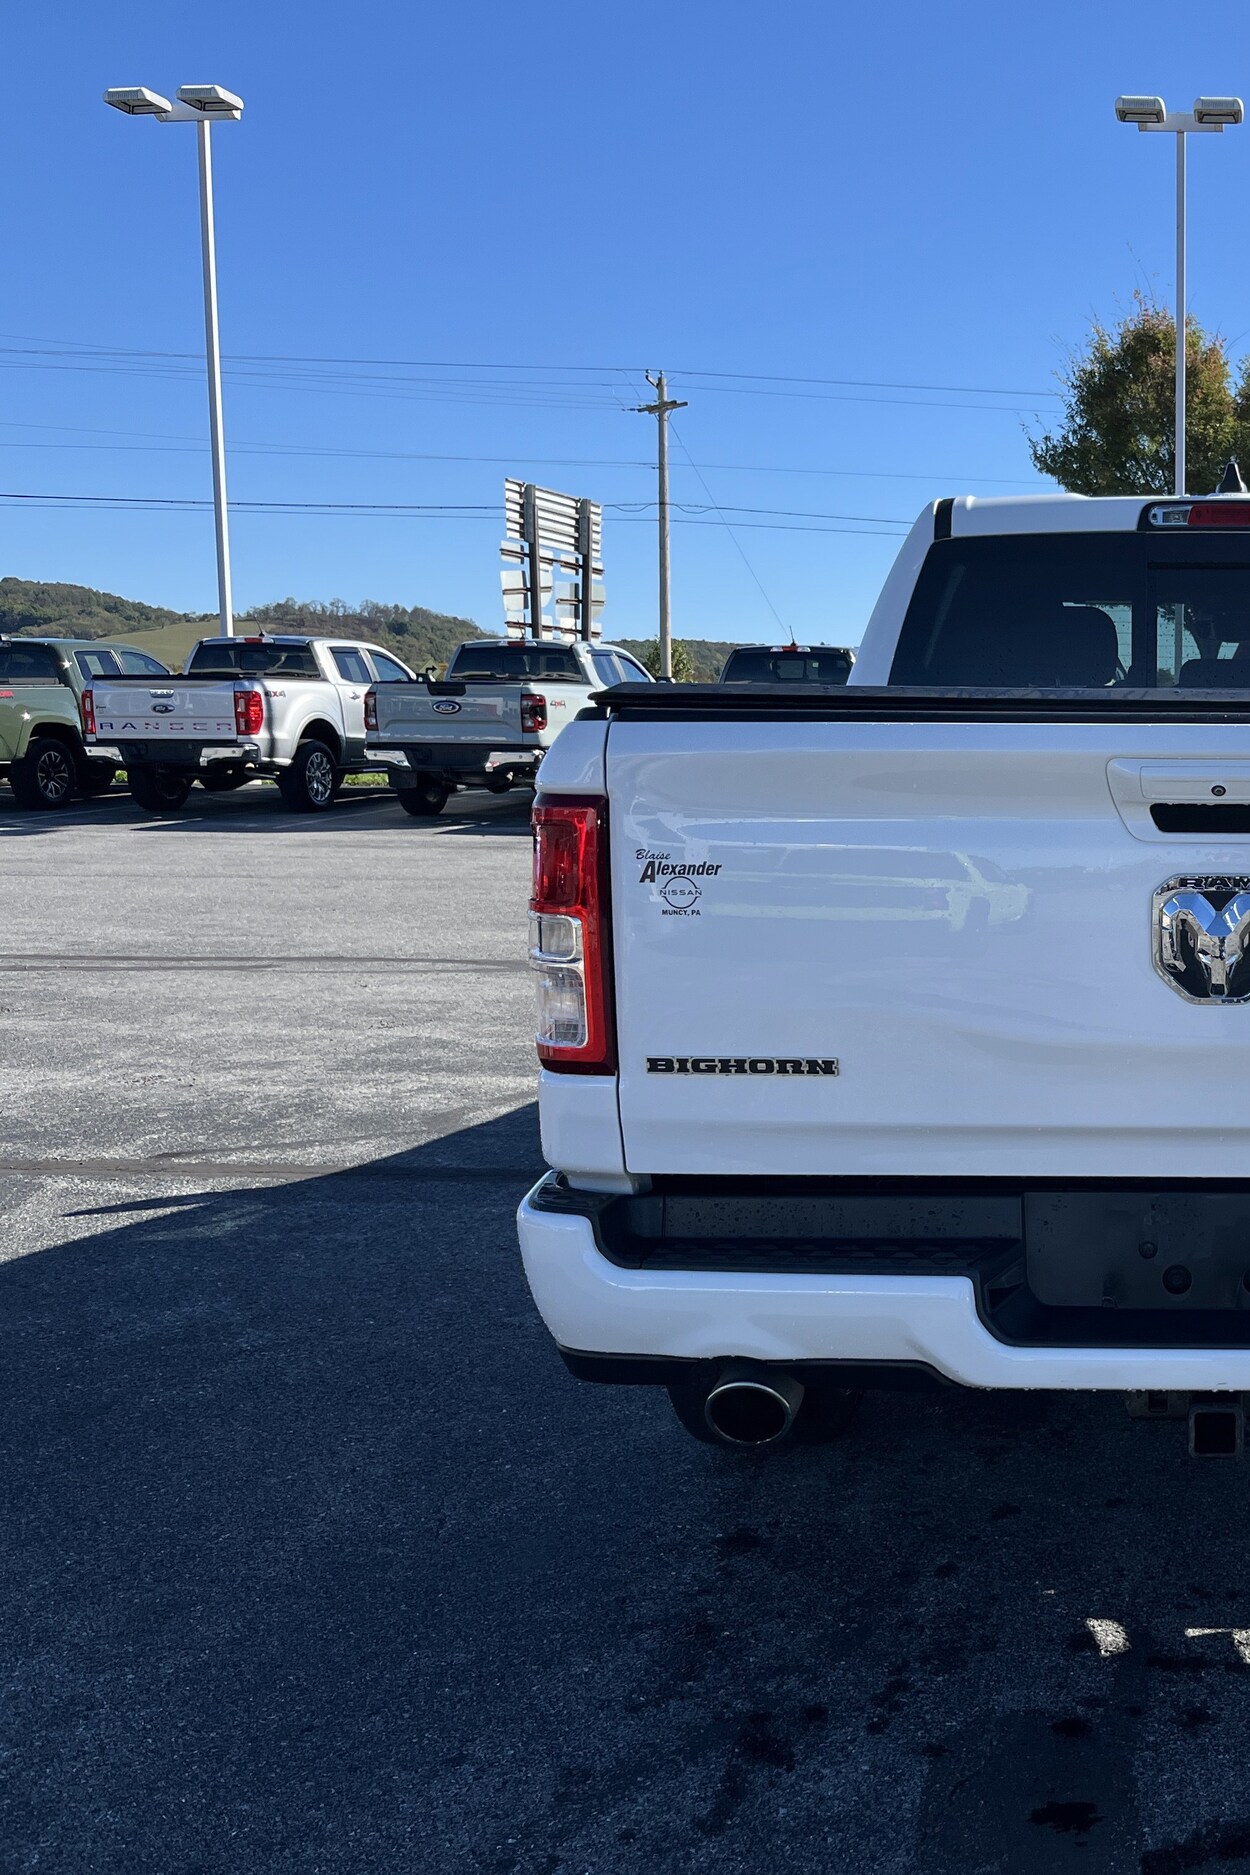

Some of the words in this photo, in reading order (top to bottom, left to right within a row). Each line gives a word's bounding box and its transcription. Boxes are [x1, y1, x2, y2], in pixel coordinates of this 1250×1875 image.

[100, 722, 232, 731] RANGER
[635, 848, 671, 860] Blaise
[639, 860, 722, 883] Alexander
[646, 1056, 839, 1077] BIGHORN
